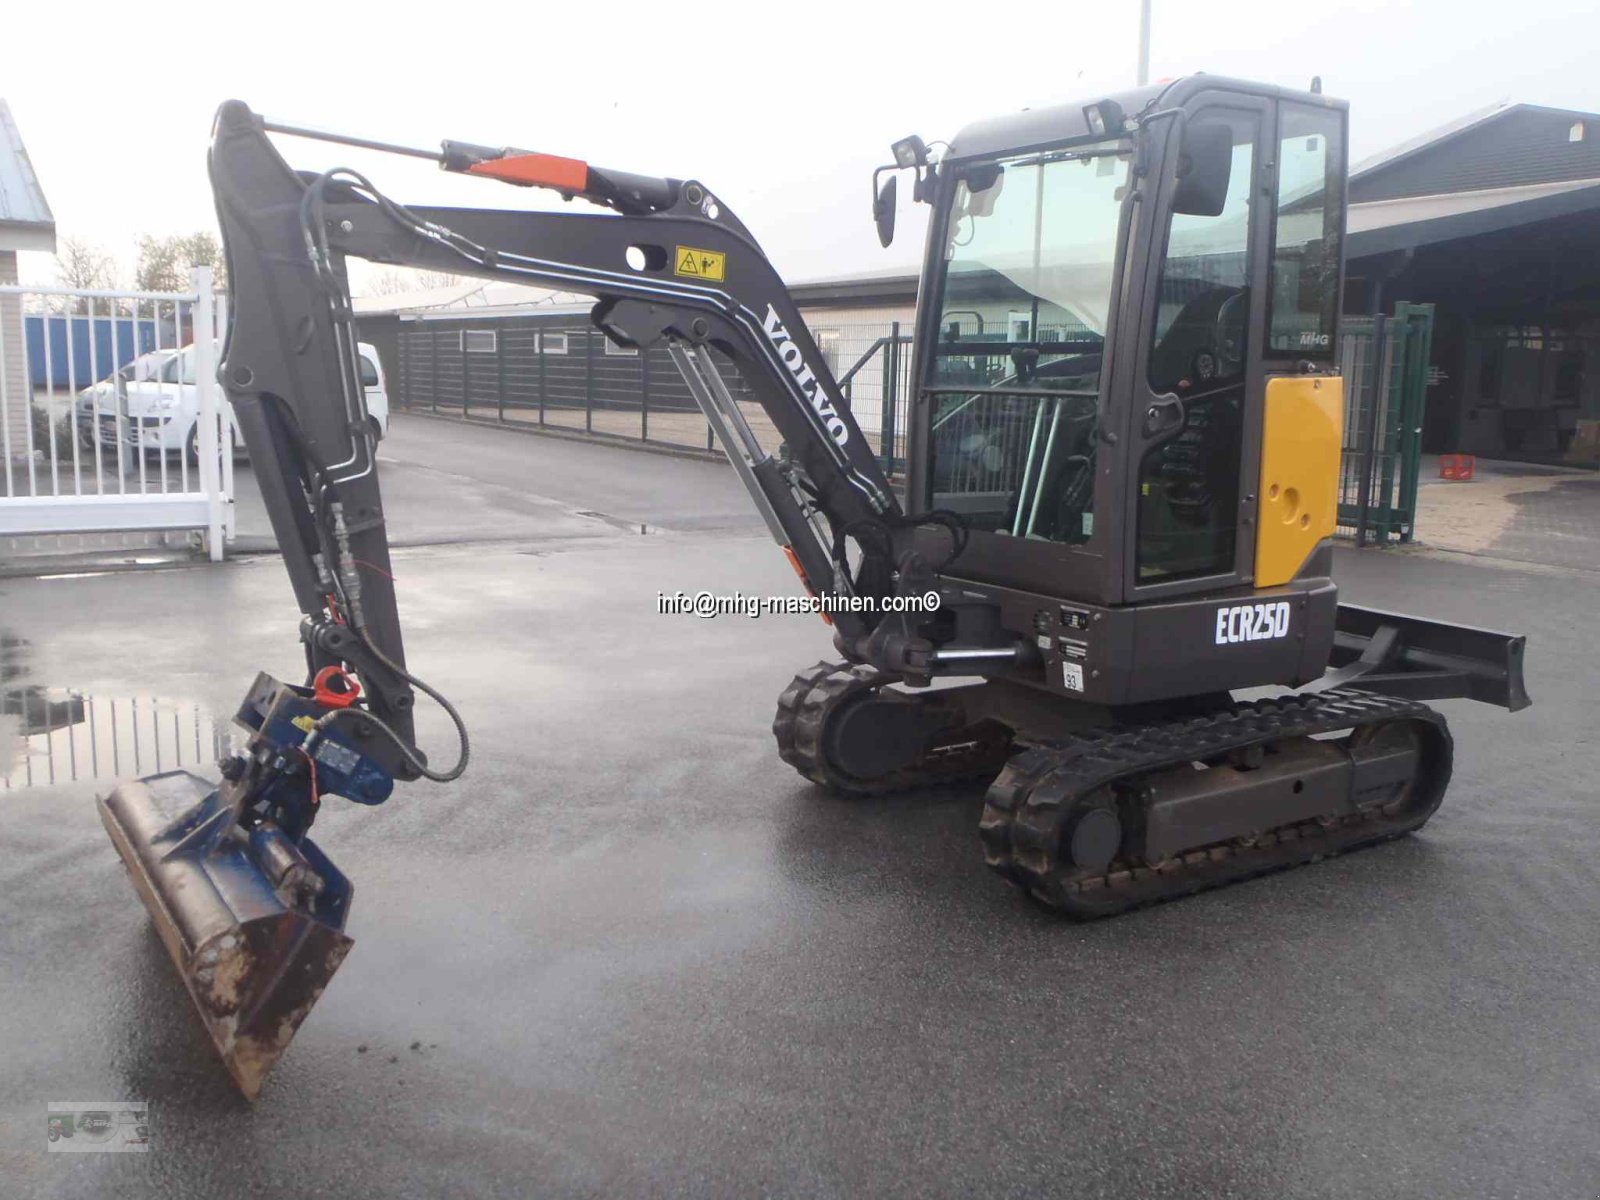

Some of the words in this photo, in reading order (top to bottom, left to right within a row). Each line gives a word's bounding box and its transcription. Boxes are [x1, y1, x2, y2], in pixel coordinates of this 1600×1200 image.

[1300, 332, 1329, 345] MHG
[763, 303, 849, 446] VOLVO
[1215, 602, 1290, 644] ECR25D
